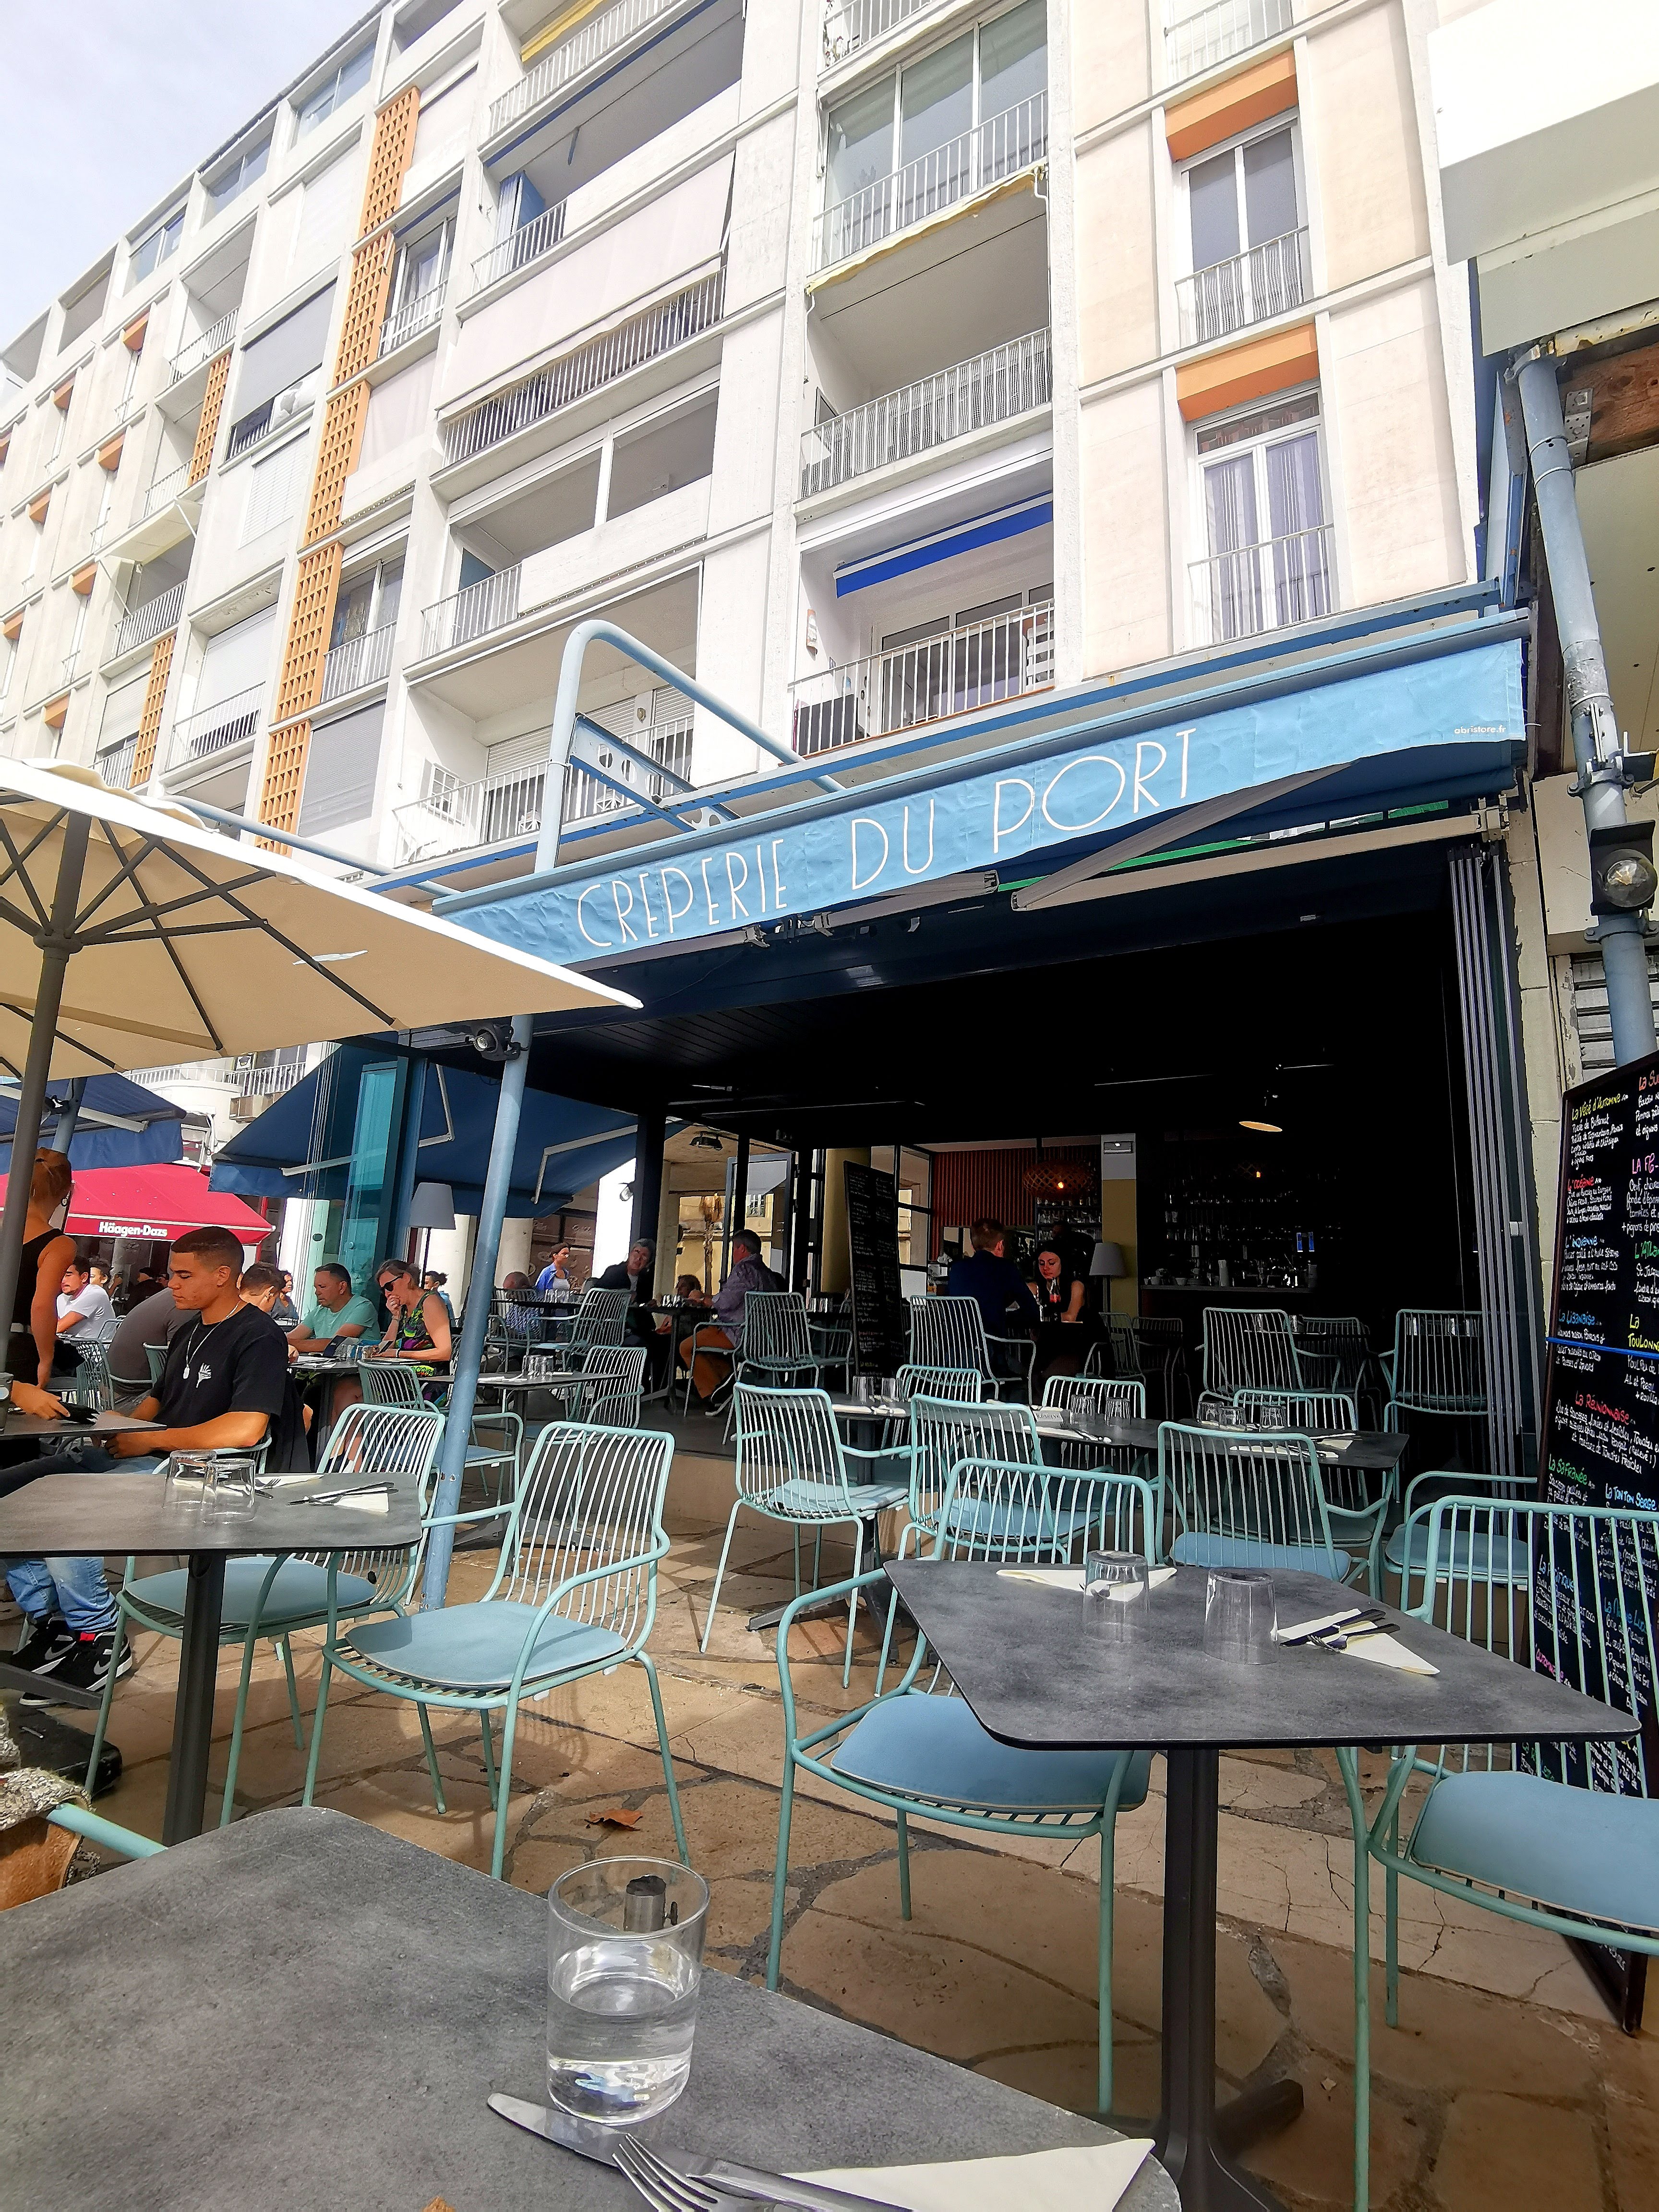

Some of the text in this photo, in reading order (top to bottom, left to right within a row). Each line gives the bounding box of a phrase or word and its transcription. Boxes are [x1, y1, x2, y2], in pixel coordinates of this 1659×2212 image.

[1454, 724, 1507, 734] abristore.fr
[577, 727, 1197, 949] CREPERIE DU PORT
